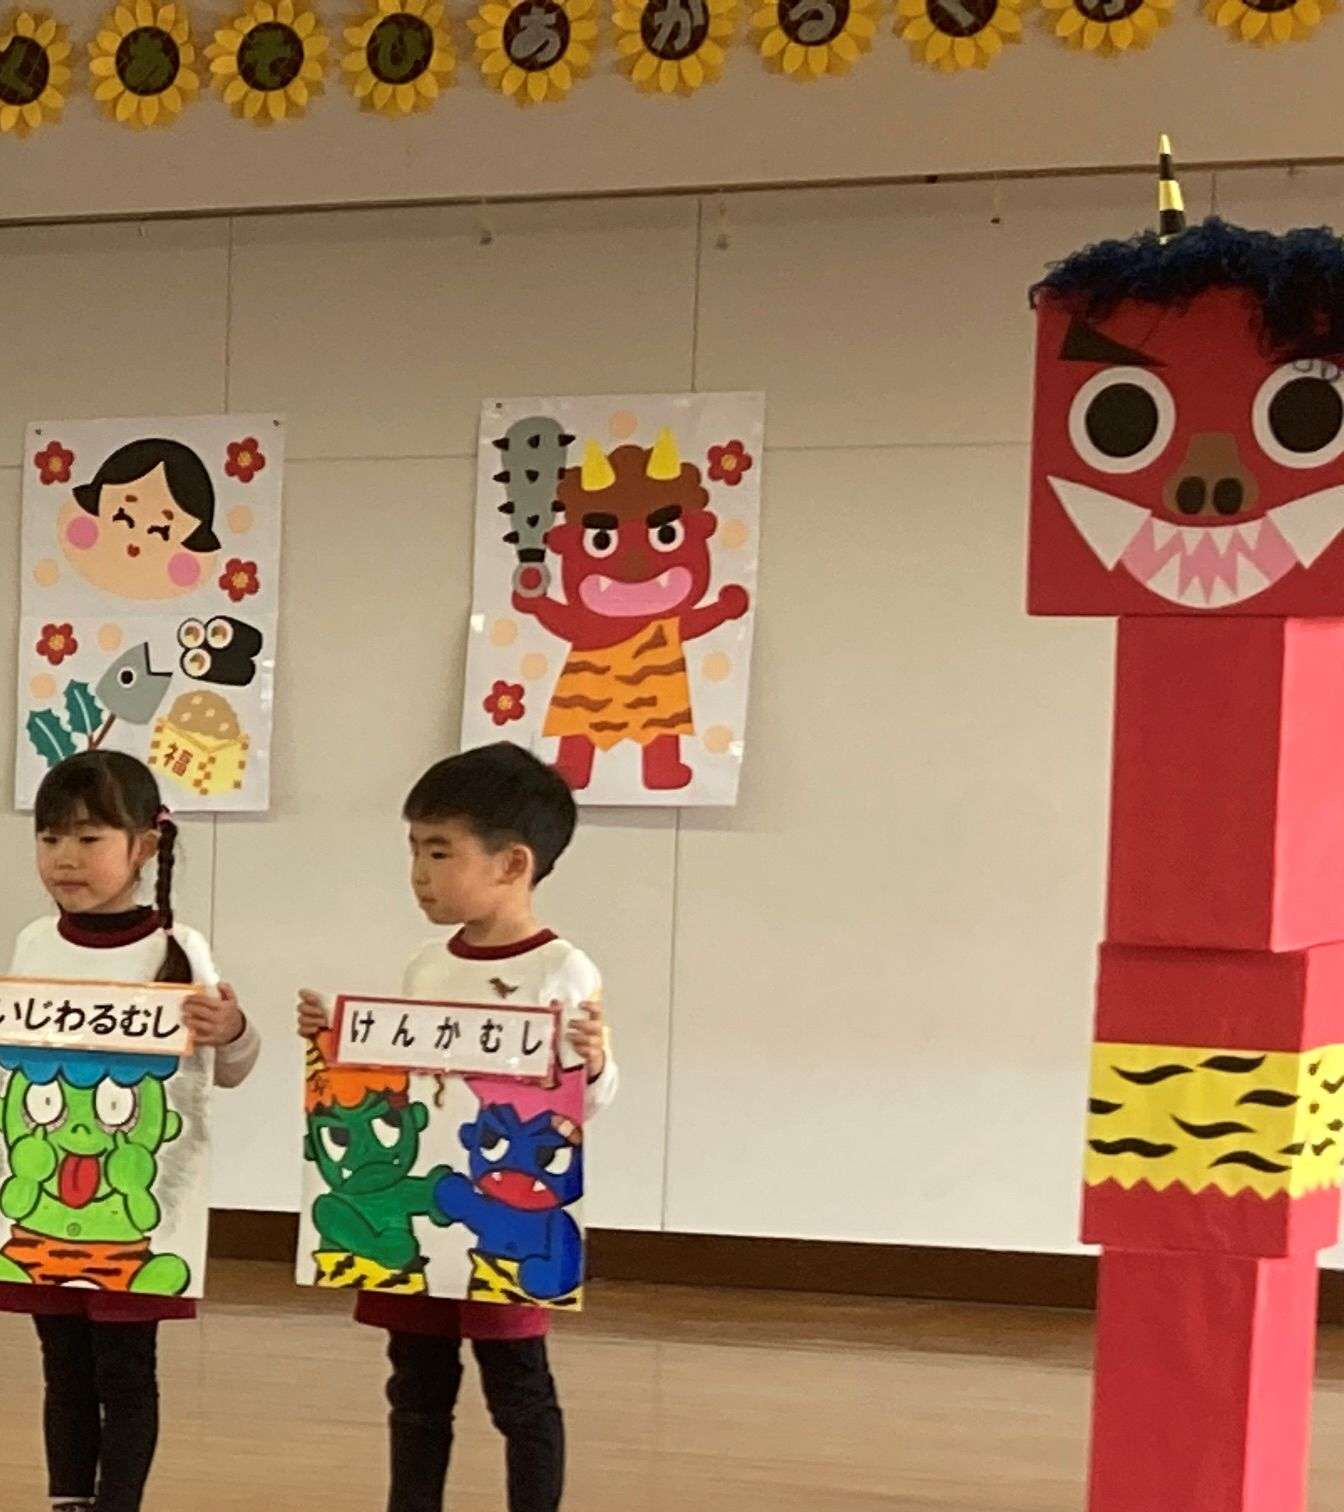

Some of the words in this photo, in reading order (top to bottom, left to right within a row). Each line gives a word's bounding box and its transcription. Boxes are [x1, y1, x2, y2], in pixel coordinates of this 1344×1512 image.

[163, 742, 193, 777] 福
[350, 1010, 544, 1056] けんかむし
